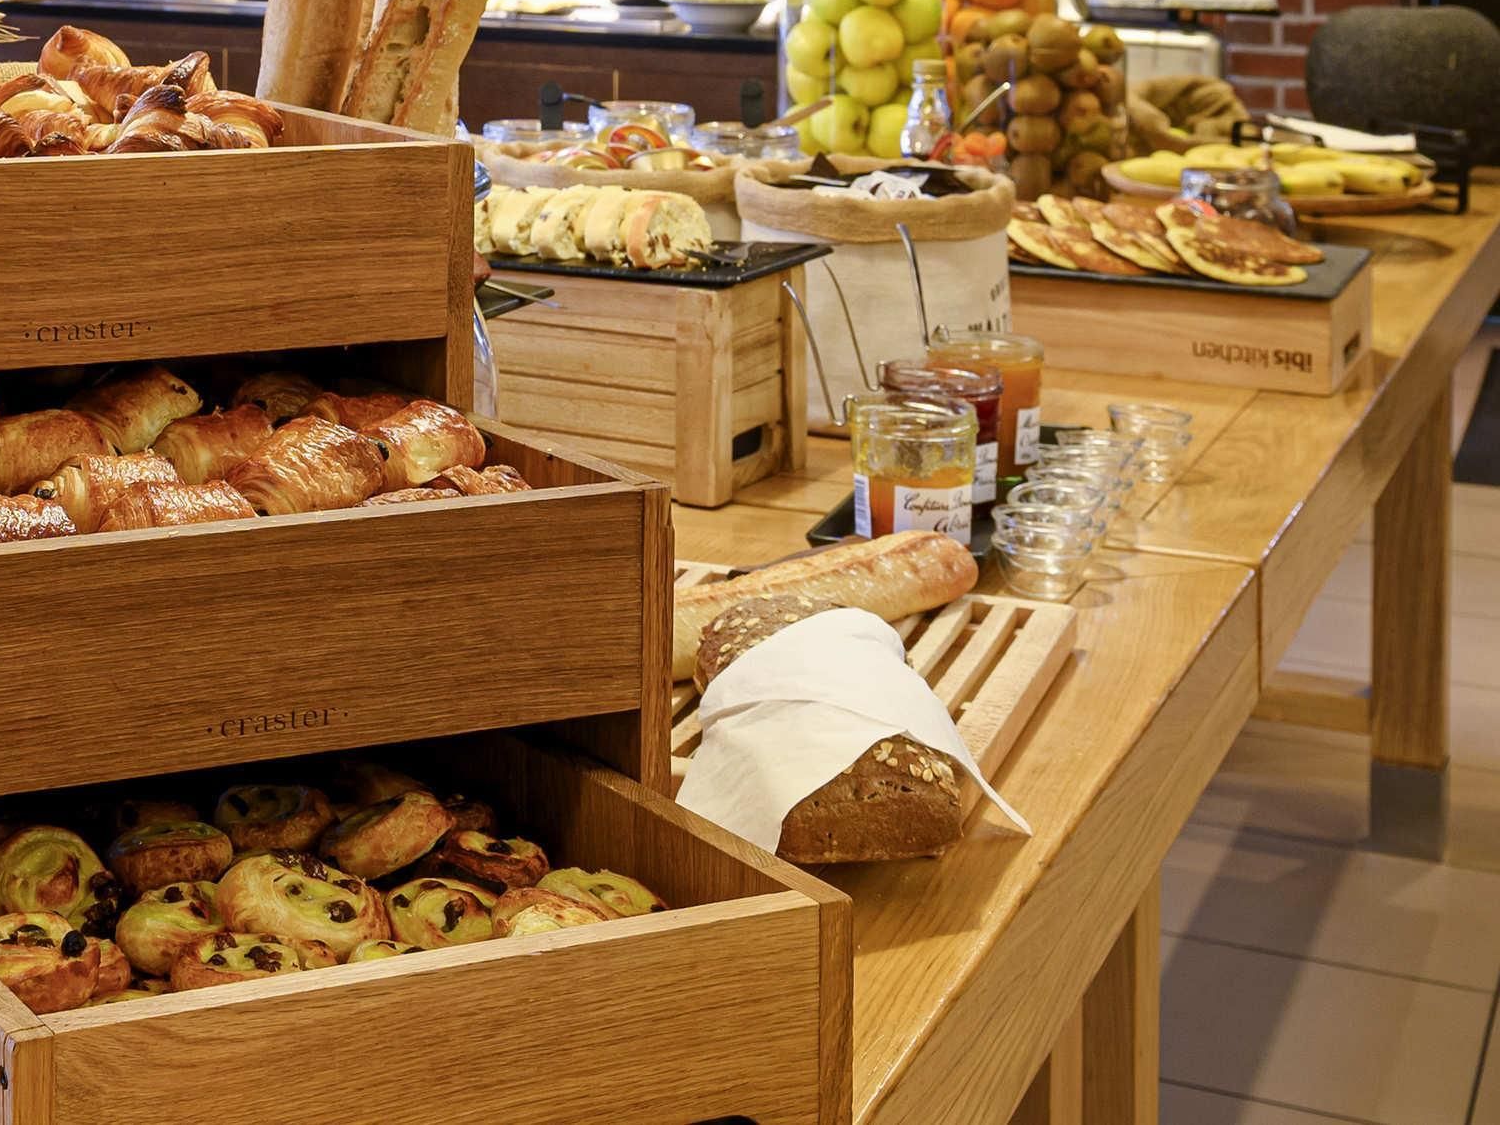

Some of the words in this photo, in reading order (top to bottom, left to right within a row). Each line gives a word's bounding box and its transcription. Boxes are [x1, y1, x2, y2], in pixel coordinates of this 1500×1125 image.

[34, 320, 143, 343] craster
[1191, 340, 1269, 369] kitchen
[1273, 348, 1313, 373] ibis
[218, 707, 337, 738] craster
